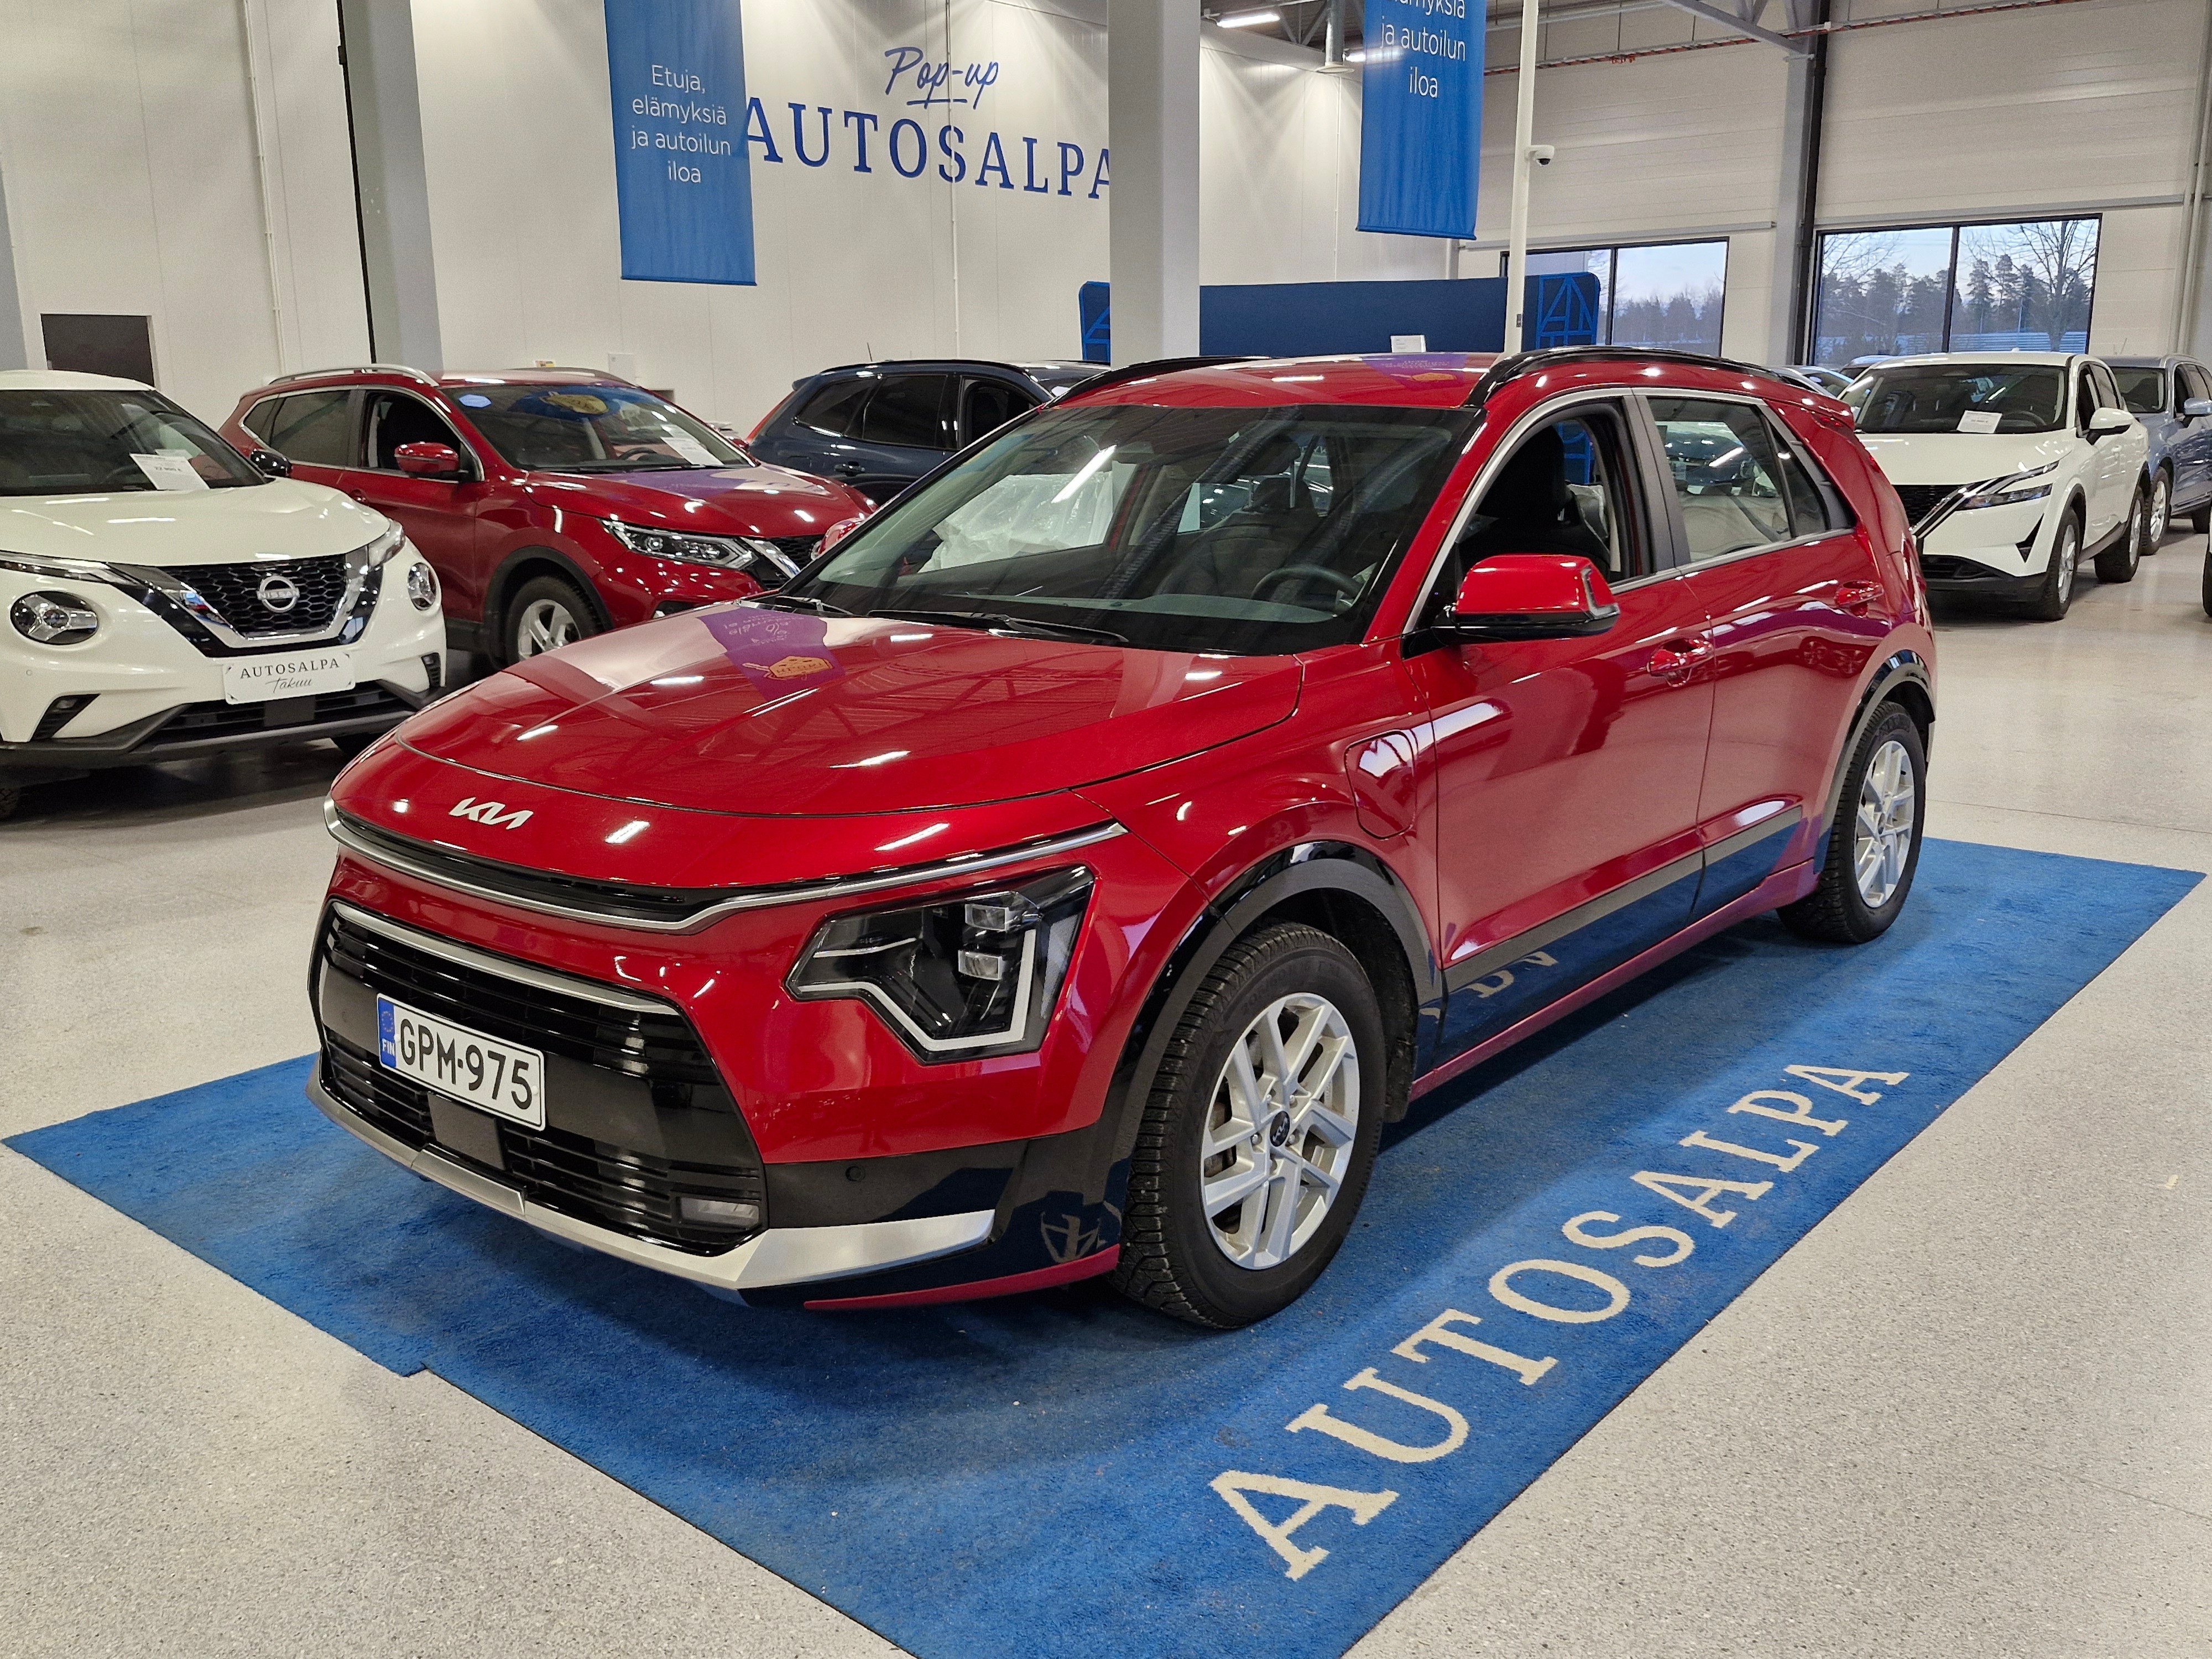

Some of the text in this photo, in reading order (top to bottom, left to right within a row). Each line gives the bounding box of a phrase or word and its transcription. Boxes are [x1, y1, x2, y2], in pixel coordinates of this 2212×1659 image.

[1379, 15, 1465, 61] ja autoilun
[651, 64, 705, 94] Etuja,
[885, 46, 999, 110] Pop-up
[1408, 66, 1438, 98] iloa
[632, 94, 727, 126] elämyksiä
[631, 125, 731, 156] ja autoilun
[744, 97, 1109, 200] AUTOSALPA
[667, 160, 701, 184] iloa
[257, 588, 300, 600] NISSAN
[240, 658, 340, 679] AUTOSALPA
[265, 677, 312, 693] Takuu
[448, 796, 534, 830] KIA
[382, 1038, 395, 1056] FIN
[400, 1018, 533, 1110] GPM-975
[1209, 1063, 1910, 1582] AUTOSALPA
